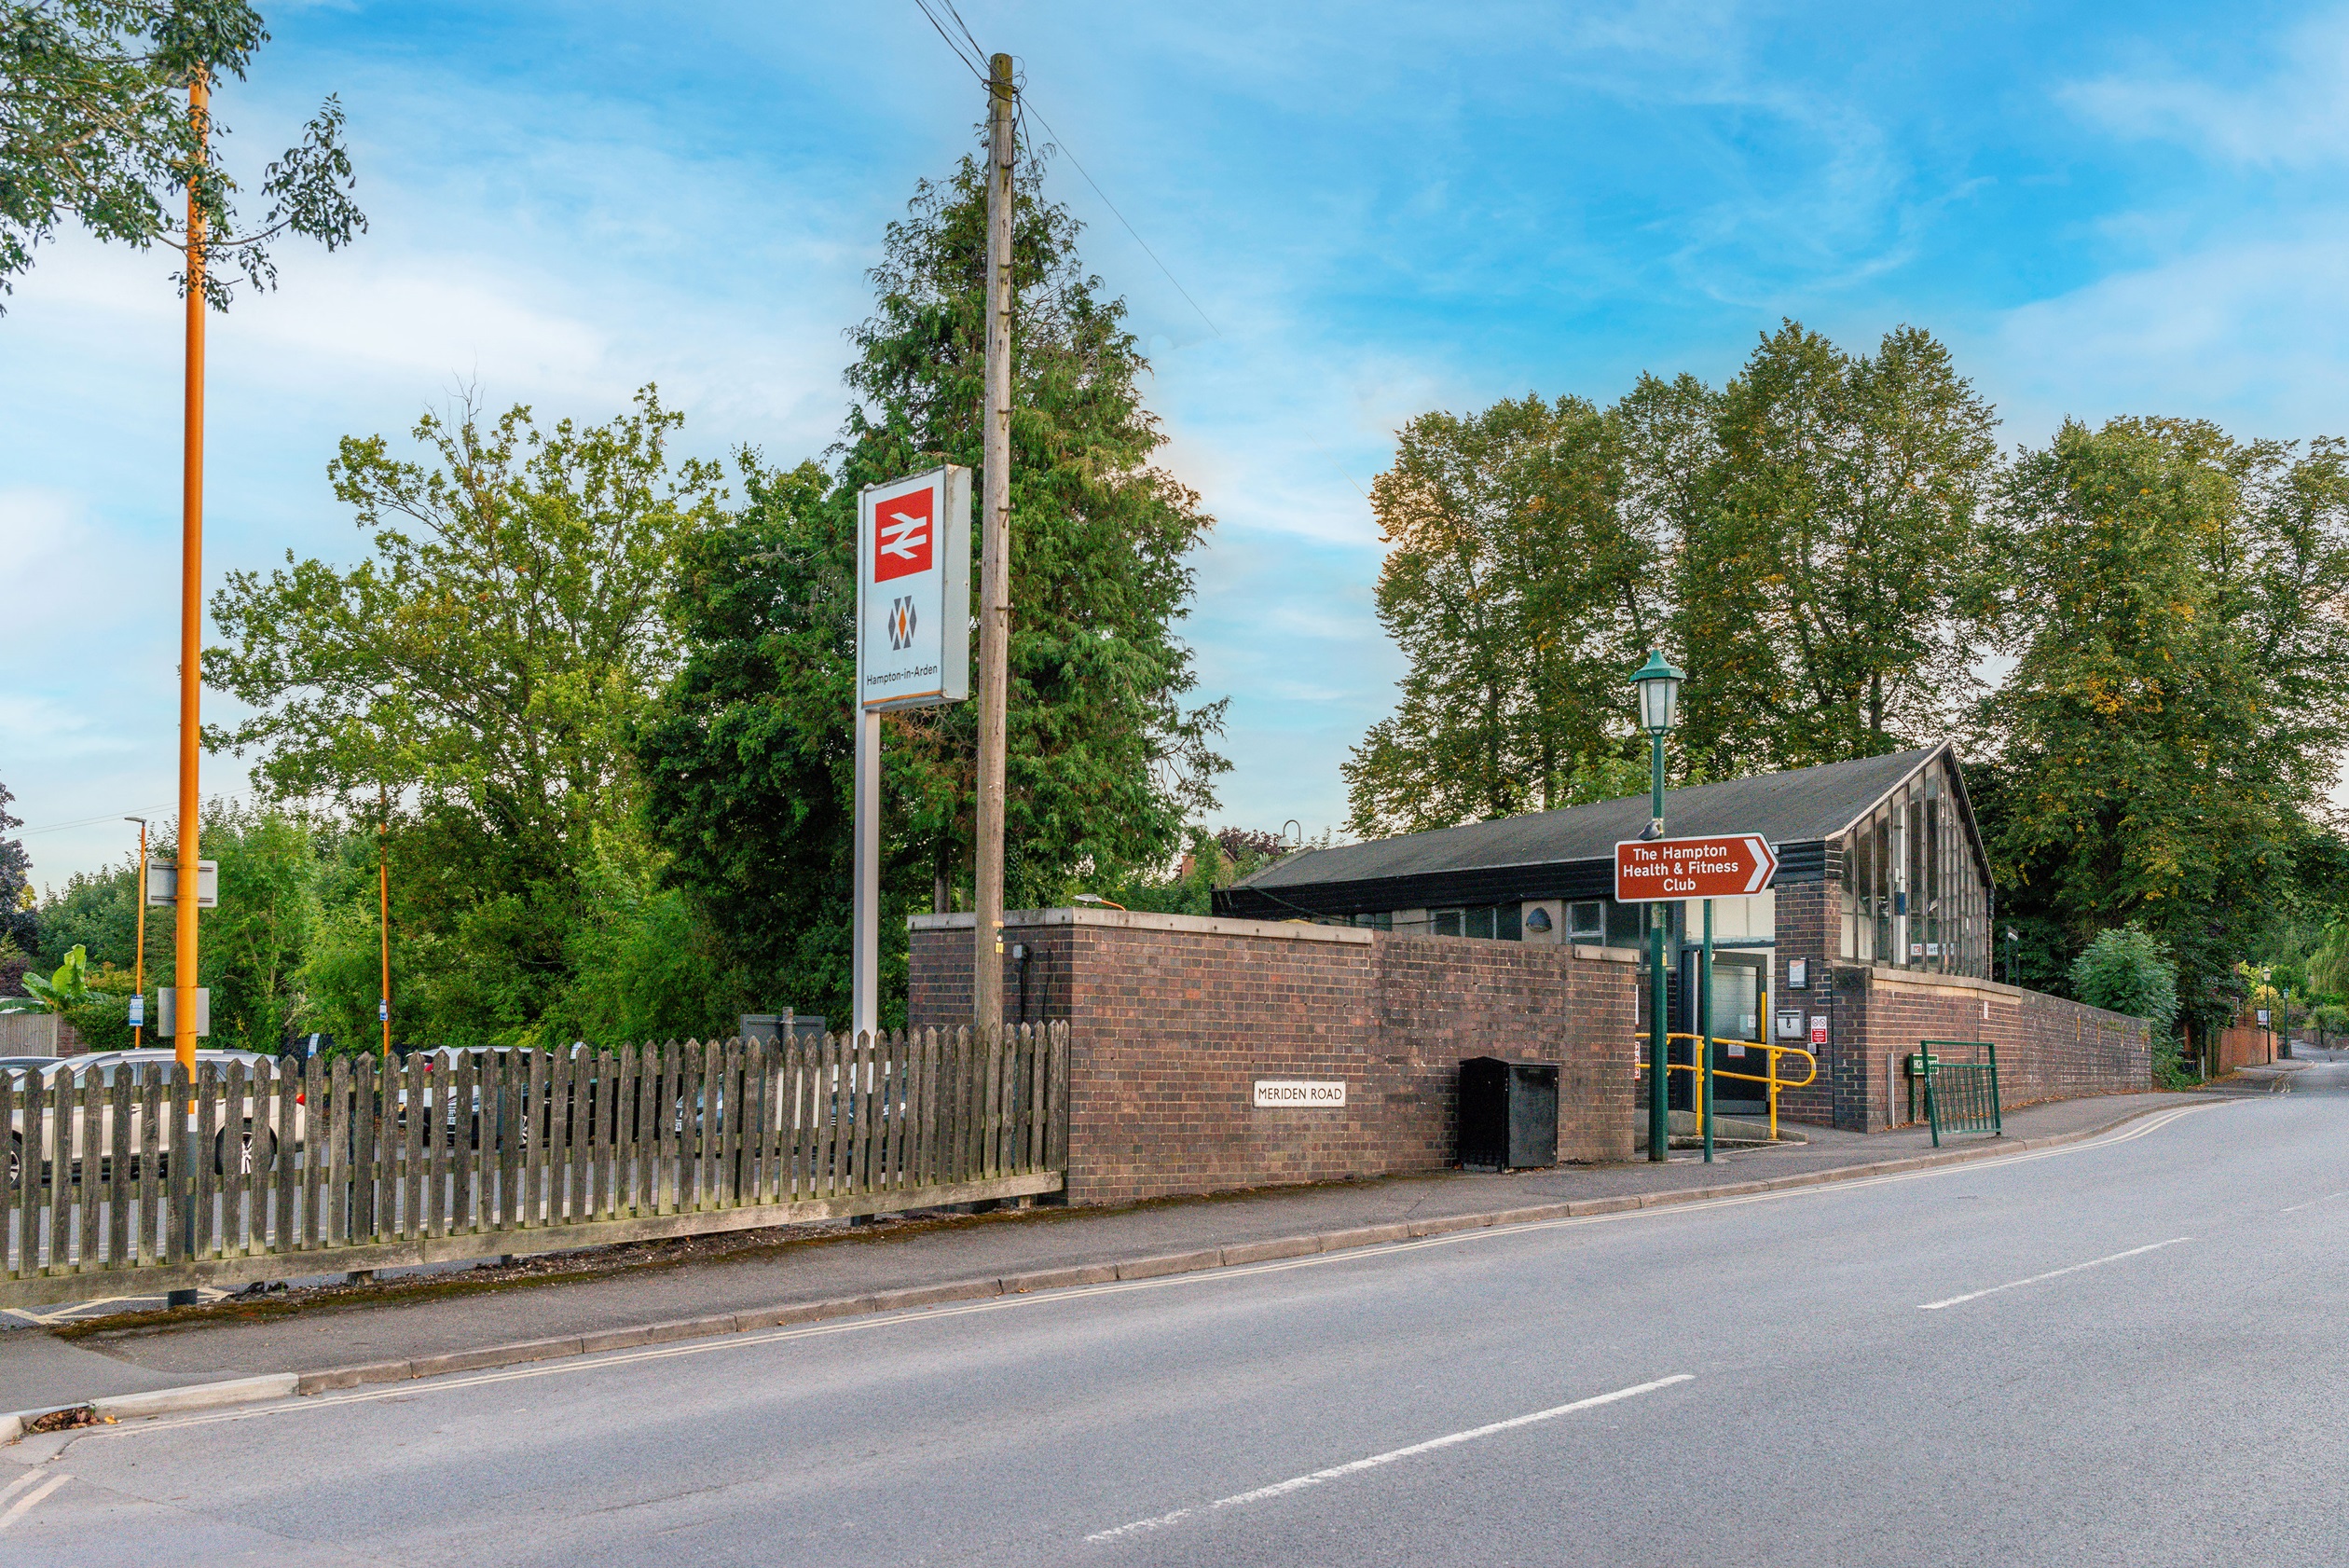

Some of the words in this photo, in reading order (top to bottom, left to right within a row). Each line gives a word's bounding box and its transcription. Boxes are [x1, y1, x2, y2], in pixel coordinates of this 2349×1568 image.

[867, 664, 938, 685] Hampton-in-Arden
[1632, 847, 1657, 861] The
[1662, 845, 1727, 860] Hampton
[1623, 862, 1669, 877] Health
[1673, 861, 1683, 875] &
[1688, 860, 1739, 874] Fitness
[1663, 877, 1696, 892] Club
[1258, 1088, 1307, 1100] MERIDEN
[1311, 1088, 1342, 1100] ROAD
